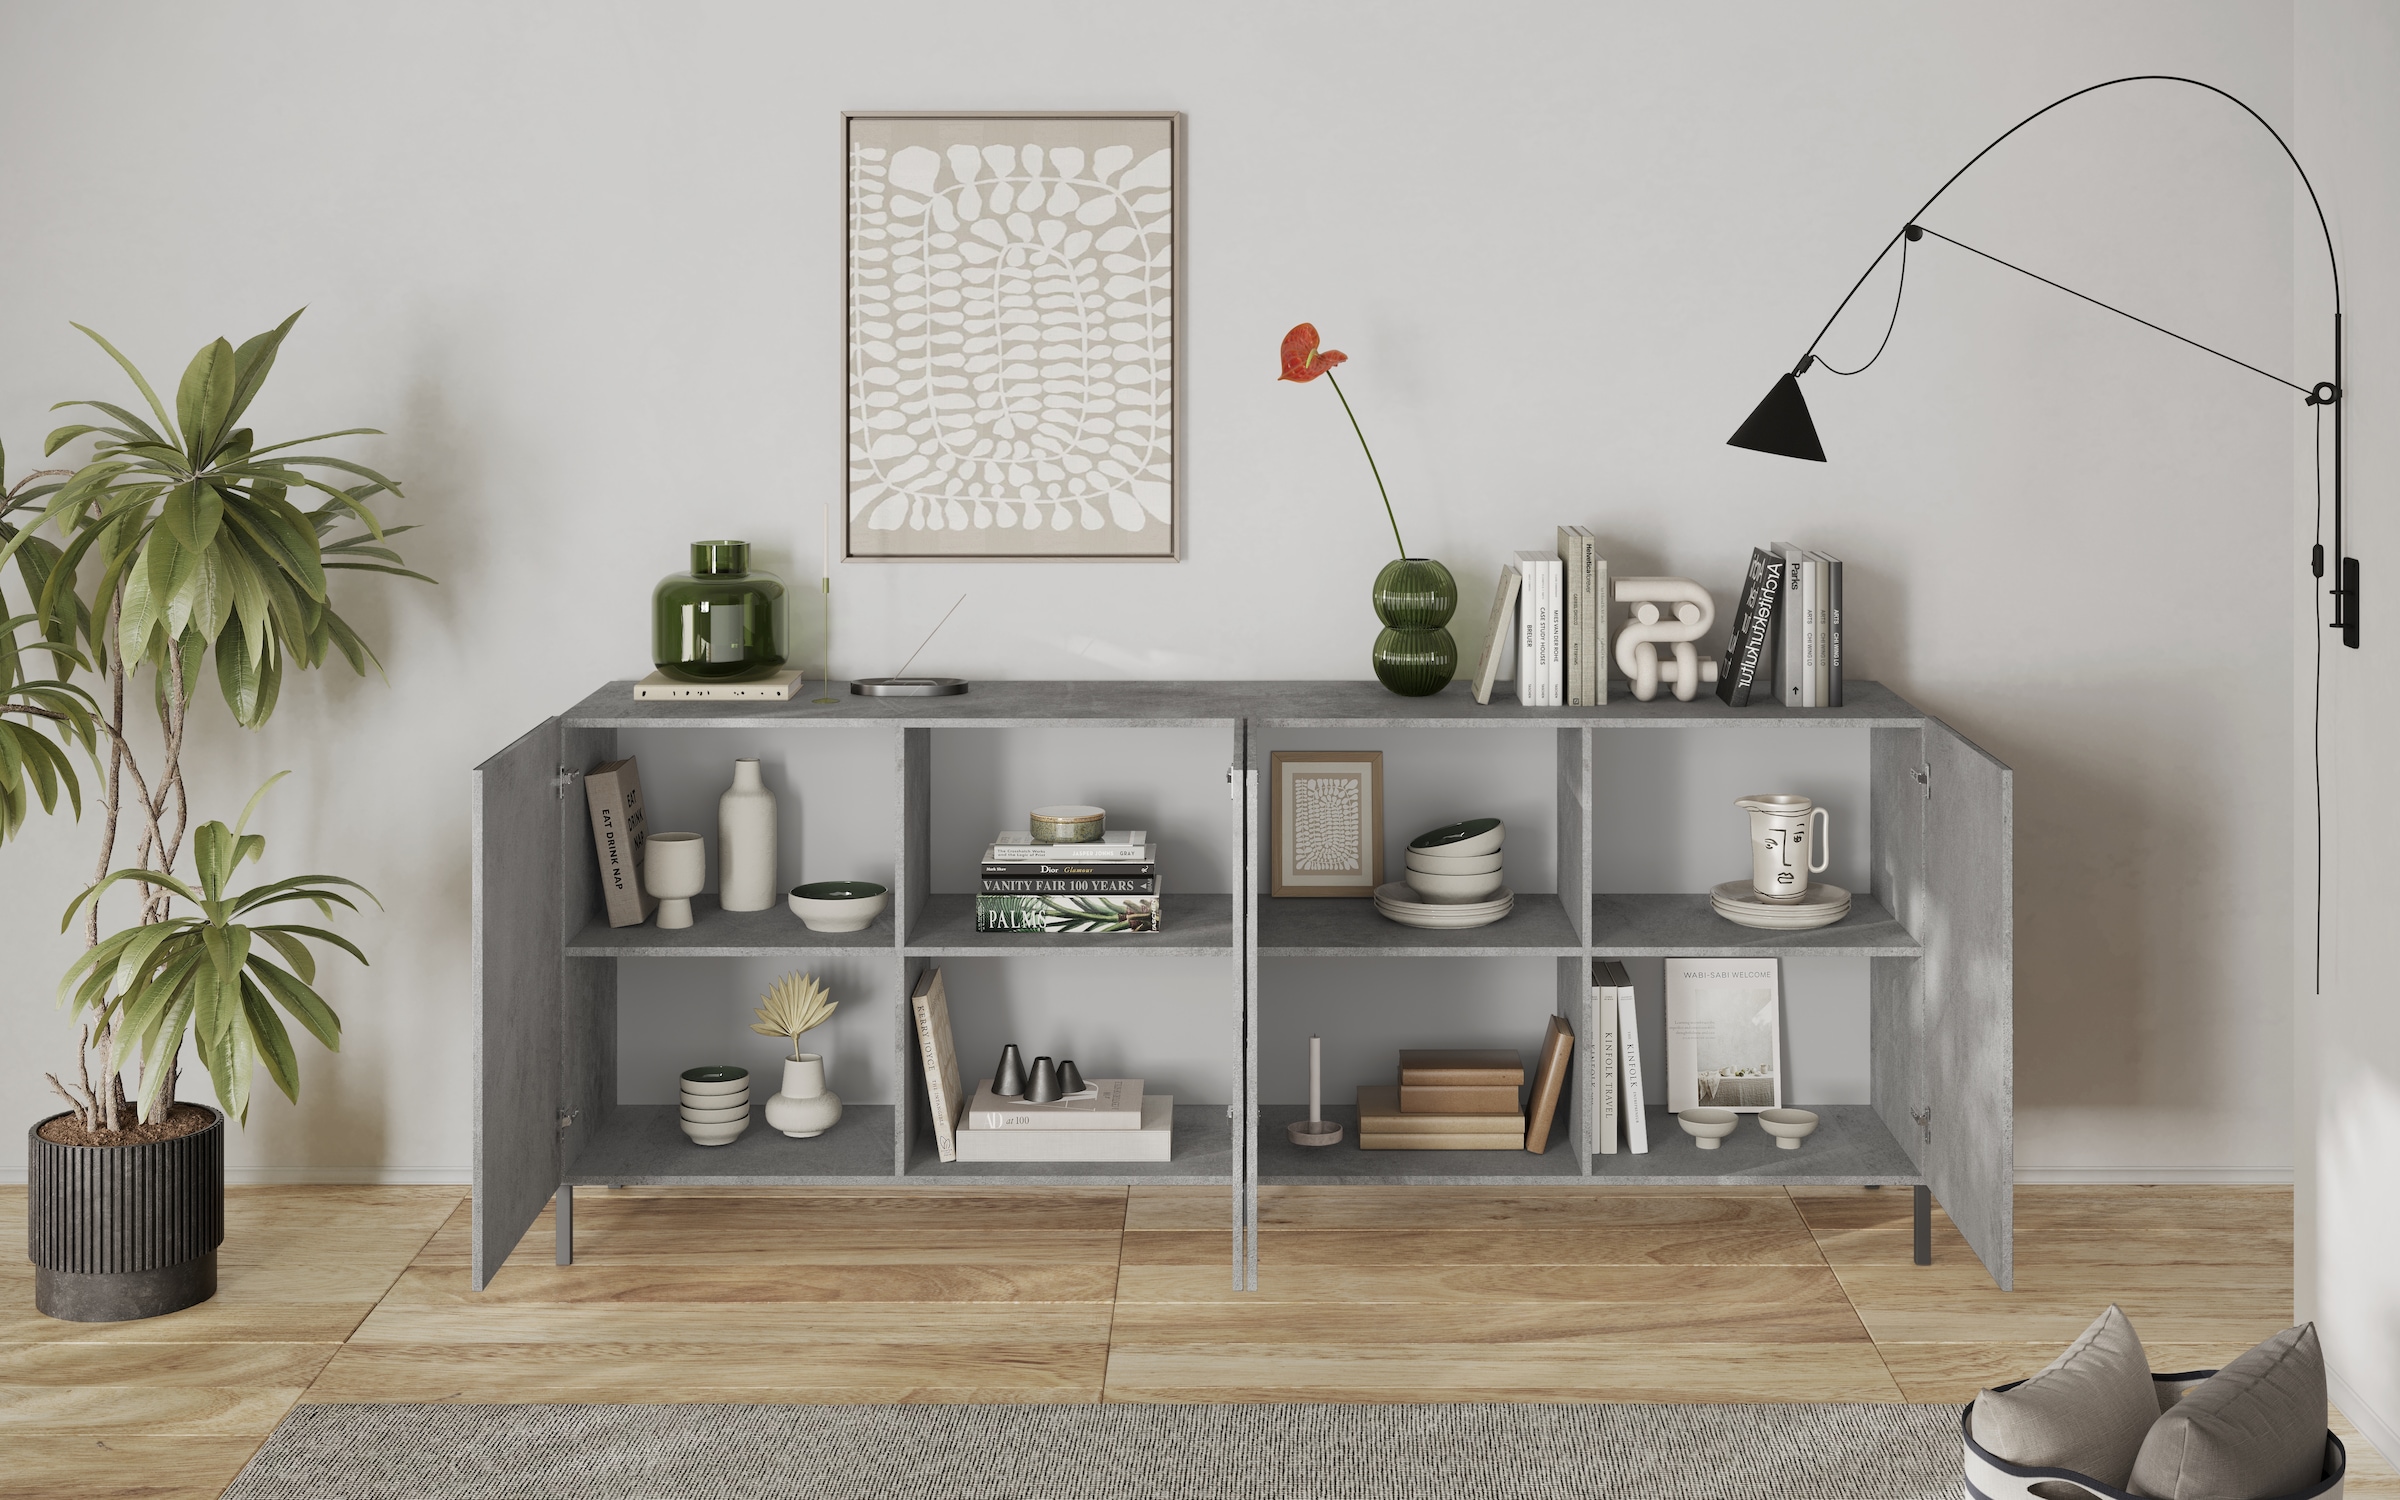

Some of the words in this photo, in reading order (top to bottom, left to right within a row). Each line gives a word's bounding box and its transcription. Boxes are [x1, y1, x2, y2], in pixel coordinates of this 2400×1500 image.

[1791, 563, 1800, 590] Parks
[627, 789, 636, 808] EAT
[602, 809, 612, 828] EAT
[627, 808, 644, 832] DRINK
[606, 832, 619, 865] DRINK
[634, 830, 644, 851] NAP
[613, 868, 623, 890] NAP
[1040, 865, 1059, 873] Dior
[983, 880, 1033, 891] VANITY
[1036, 880, 1066, 891] FAIR
[1070, 880, 1088, 891] 100
[1092, 880, 1134, 891] YEARS
[989, 909, 1047, 929] PALMS
[917, 1005, 930, 1038] KERRY
[923, 1042, 936, 1071] JOYCE
[1605, 1032, 1613, 1078] KINFOLK
[1627, 1044, 1637, 1088] KINFOLK
[1605, 1083, 1613, 1118] TRAVEL
[983, 1112, 1003, 1129] AD
[1016, 1116, 1030, 1124] 100
